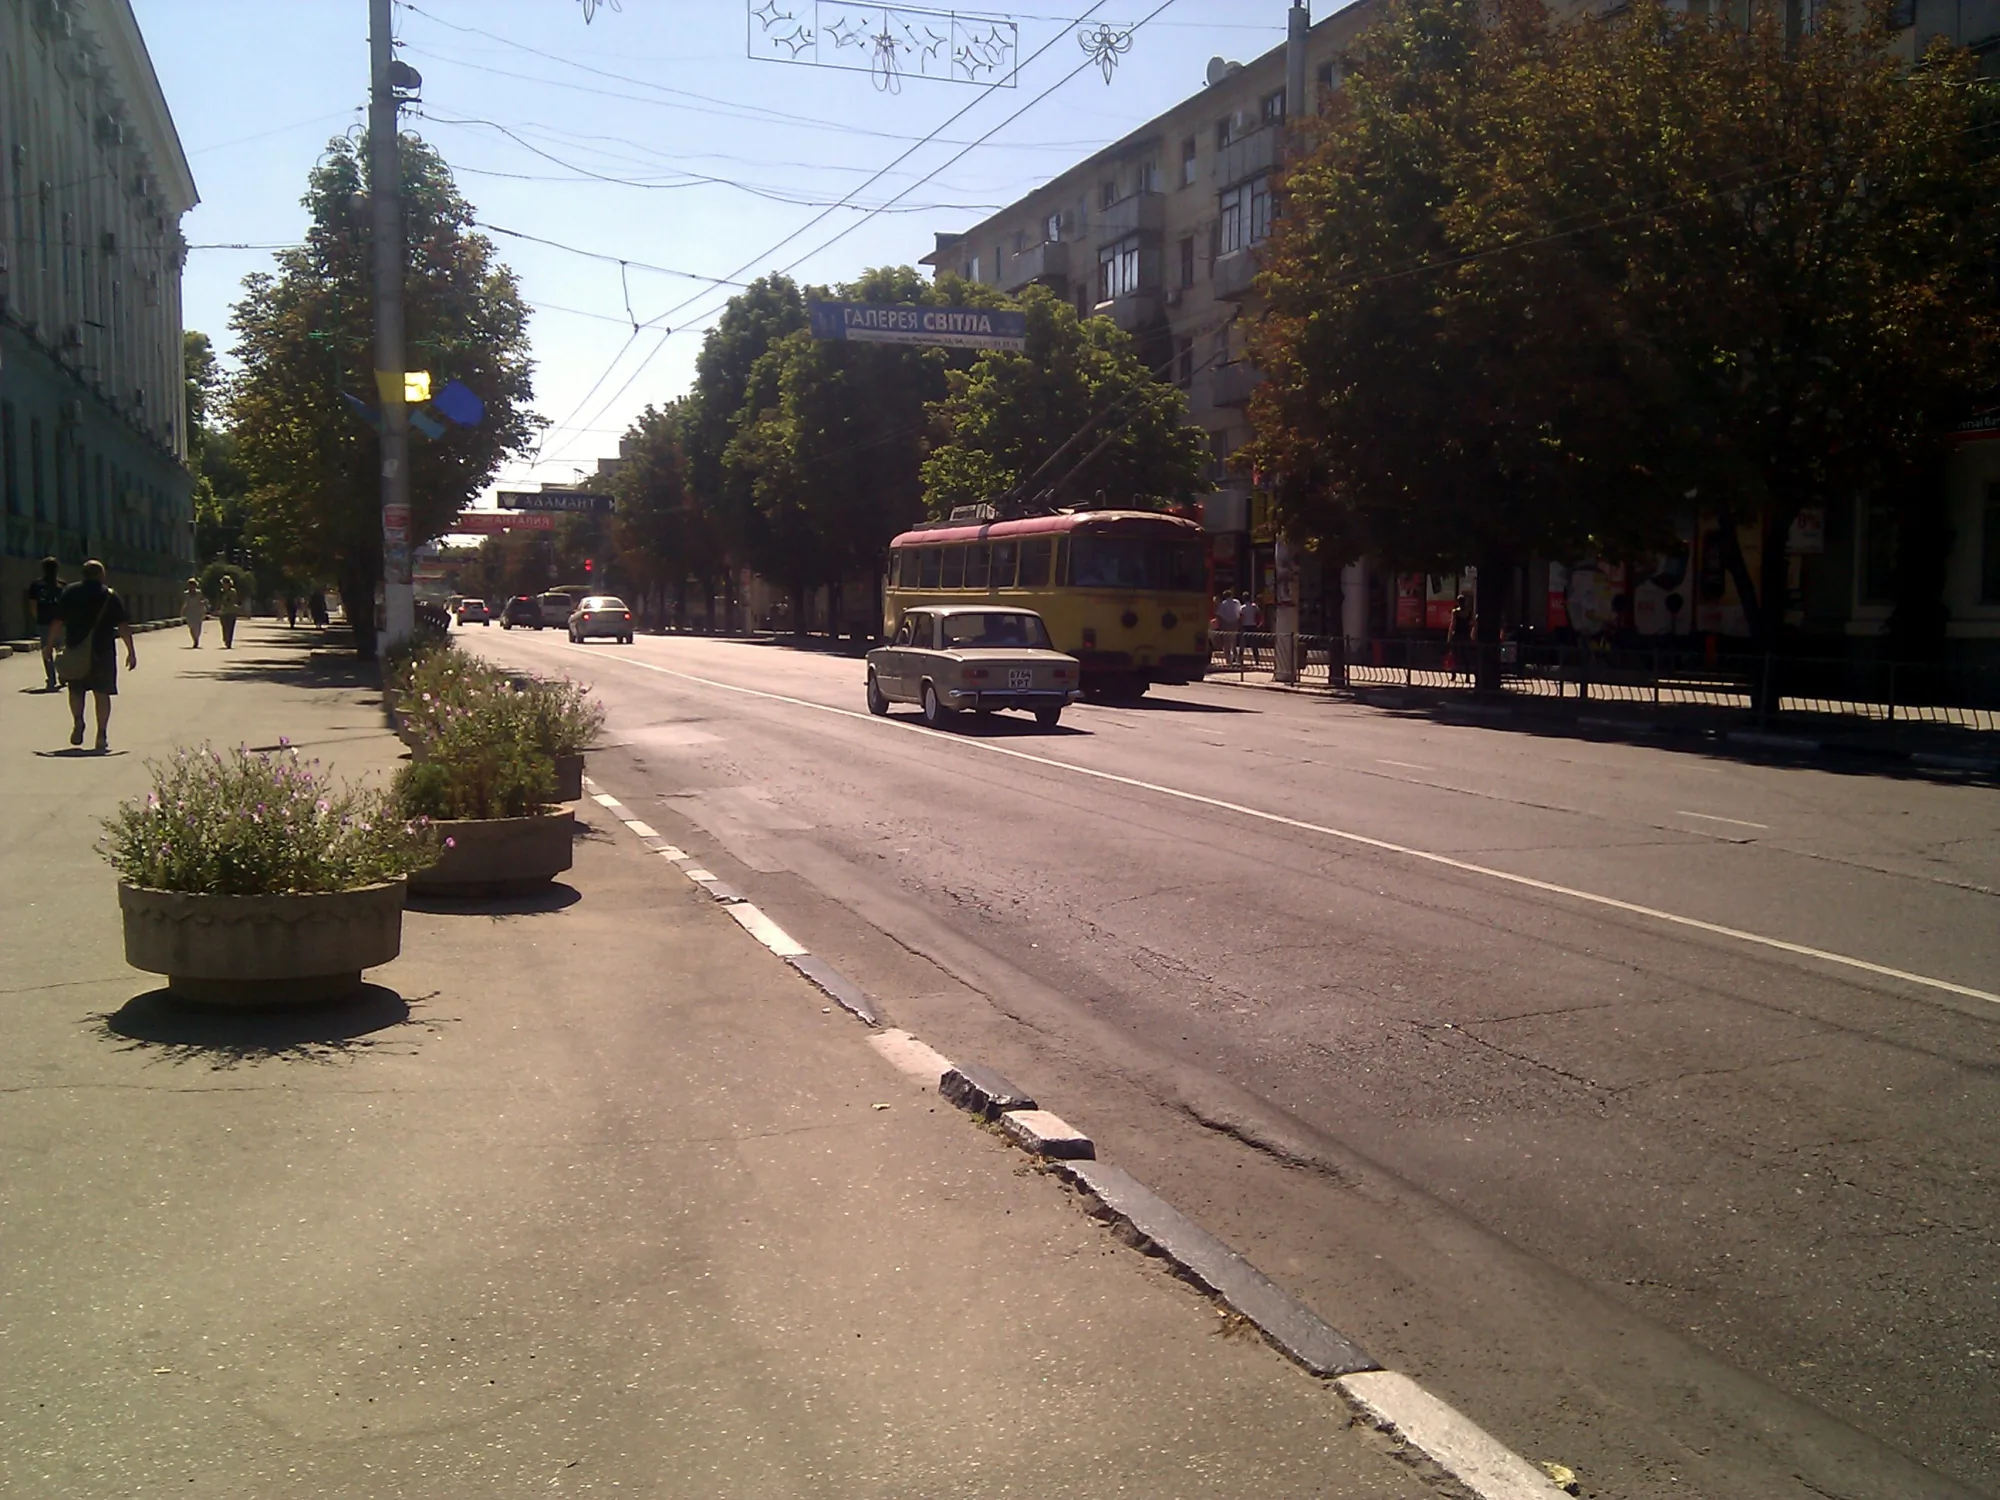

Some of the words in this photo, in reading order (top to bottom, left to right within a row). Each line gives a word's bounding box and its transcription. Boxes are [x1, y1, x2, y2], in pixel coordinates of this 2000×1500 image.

[844, 308, 918, 329] ГАЛЕРЕЯ
[923, 312, 992, 333] СВІТЛА
[524, 496, 596, 509] АДАМАНТ
